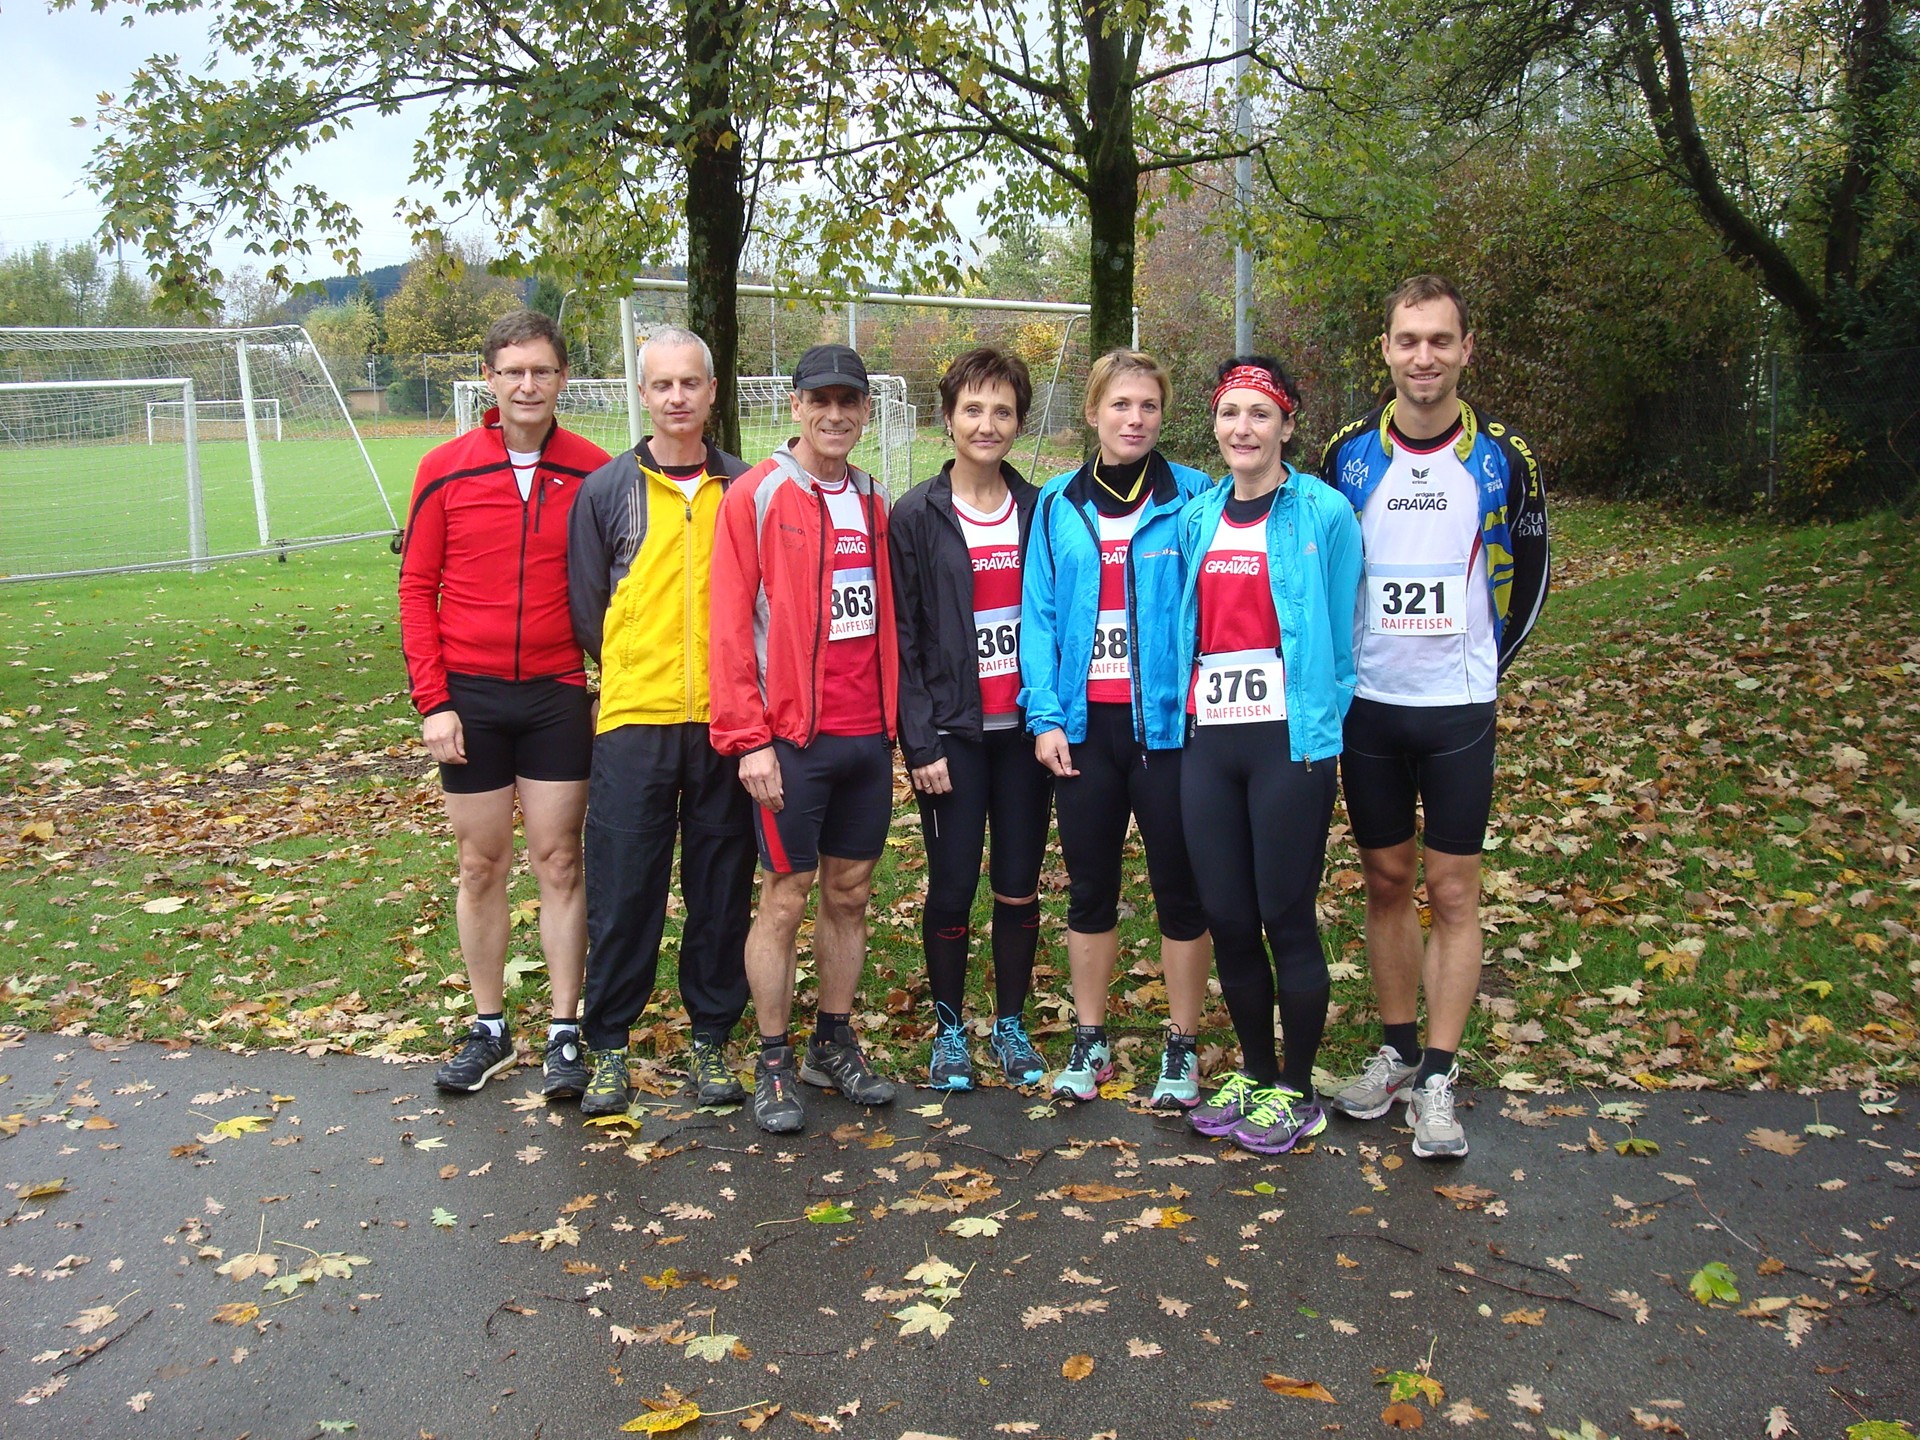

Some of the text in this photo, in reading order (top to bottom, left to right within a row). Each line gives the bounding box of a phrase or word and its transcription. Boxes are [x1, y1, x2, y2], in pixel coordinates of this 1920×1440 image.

[1509, 435, 1539, 498] GIANT
[1387, 498, 1448, 511] GRAVAG
[834, 541, 867, 554] AVAG
[1205, 560, 1260, 575] GRAVAG
[1382, 581, 1444, 614] 321
[1381, 617, 1453, 630] RAIFFEISEN
[1206, 668, 1268, 704] 376
[1206, 704, 1272, 719] RAIFFEISEN
